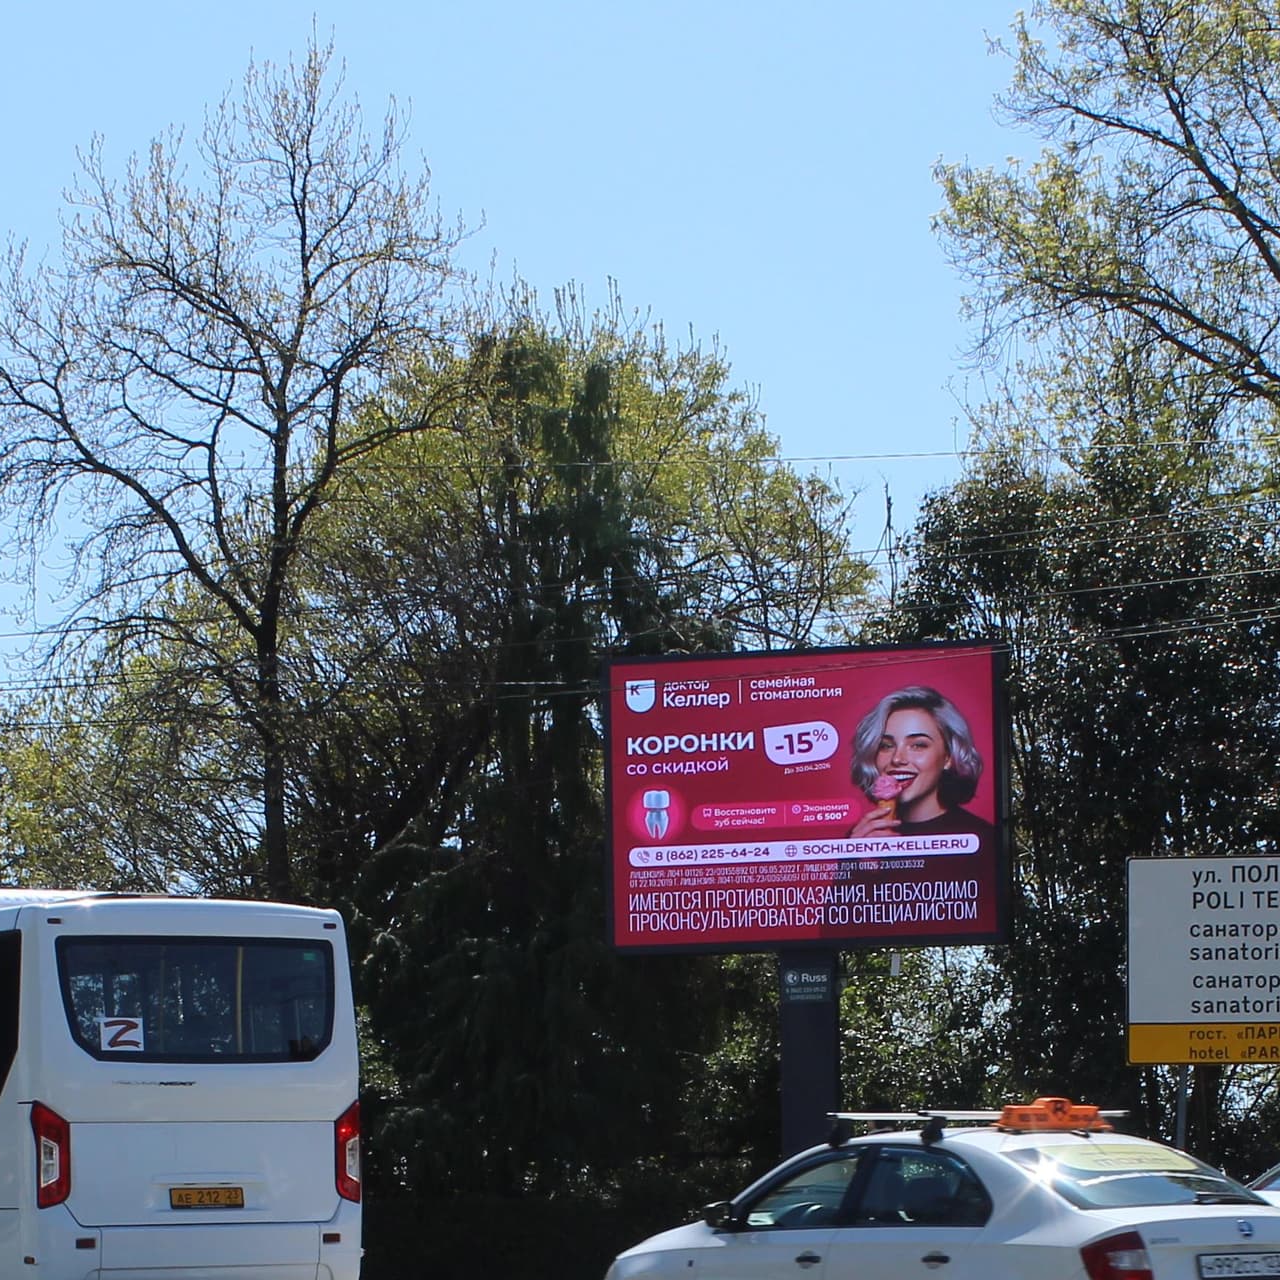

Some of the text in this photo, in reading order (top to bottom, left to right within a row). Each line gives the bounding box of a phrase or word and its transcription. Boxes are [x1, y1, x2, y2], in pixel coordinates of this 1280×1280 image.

[750, 676, 816, 689] семейная
[663, 692, 731, 709] Келлер
[750, 687, 843, 701] стоматология
[627, 731, 755, 756] КОРОНКИ
[775, 728, 829, 755] -15%
[655, 847, 770, 862] 8 (862) 225-64-24
[803, 839, 969, 855] SOCHI.DENTA-KELLER.RU
[1192, 870, 1221, 888] ул.
[629, 880, 978, 911] ИМЕЮТСЯ ПРОТИВОПОКАЗАНИЯ. НЕОБХОДИМО
[630, 902, 977, 932] ПРОКОНСУЛЬТИРОВАТЬСЯ СО СПЕЦИАЛИСТОМ
[104, 1020, 141, 1048] Z
[1189, 1029, 1227, 1040] гост.
[1189, 1046, 1229, 1059] hotel
